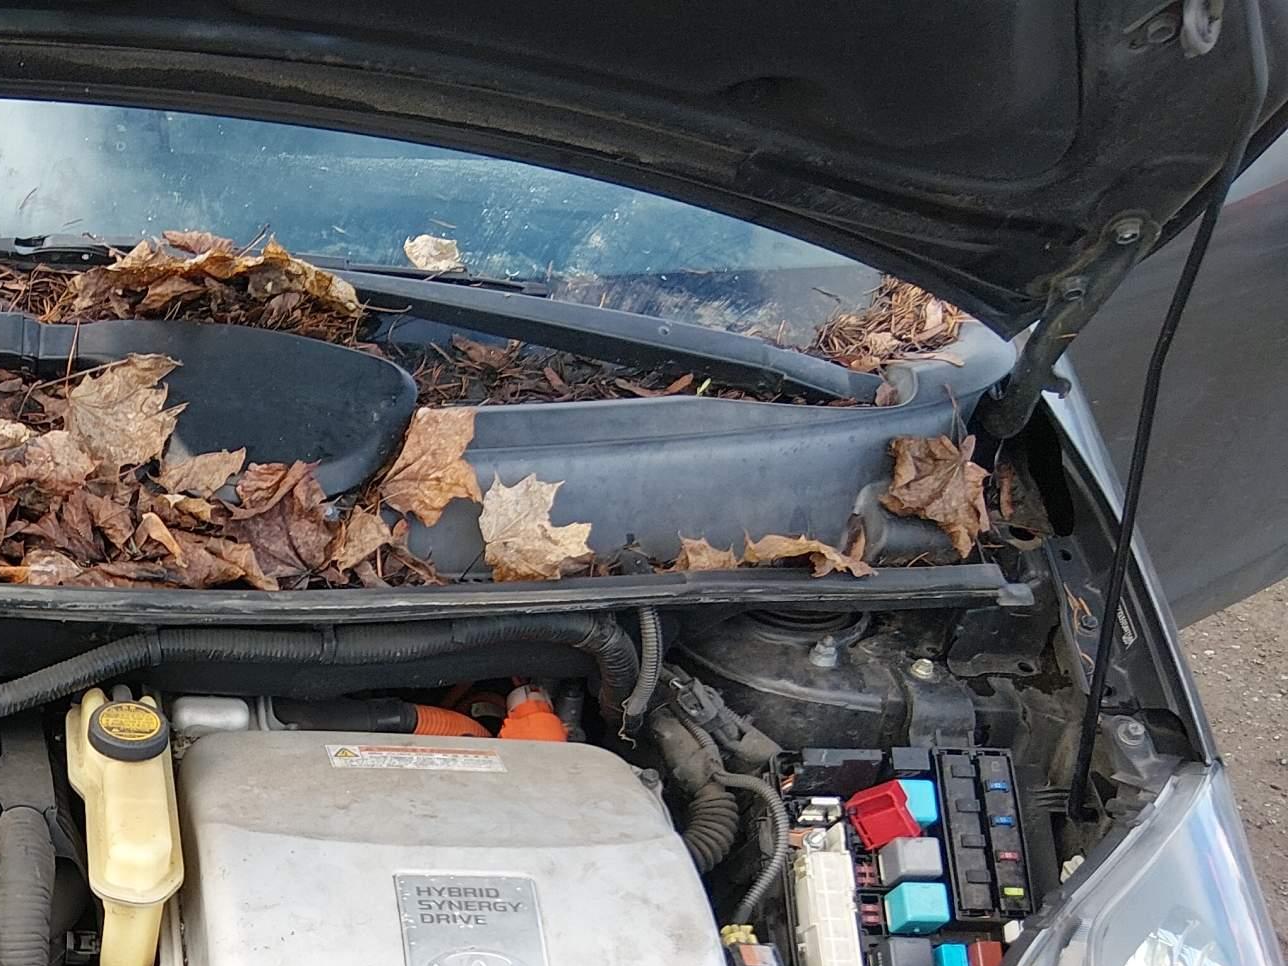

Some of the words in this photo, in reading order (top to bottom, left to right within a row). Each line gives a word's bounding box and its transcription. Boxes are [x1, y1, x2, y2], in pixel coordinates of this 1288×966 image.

[415, 886, 500, 898] HYBRID
[417, 899, 522, 913] SYNERGY
[421, 912, 489, 926] DRIVE
